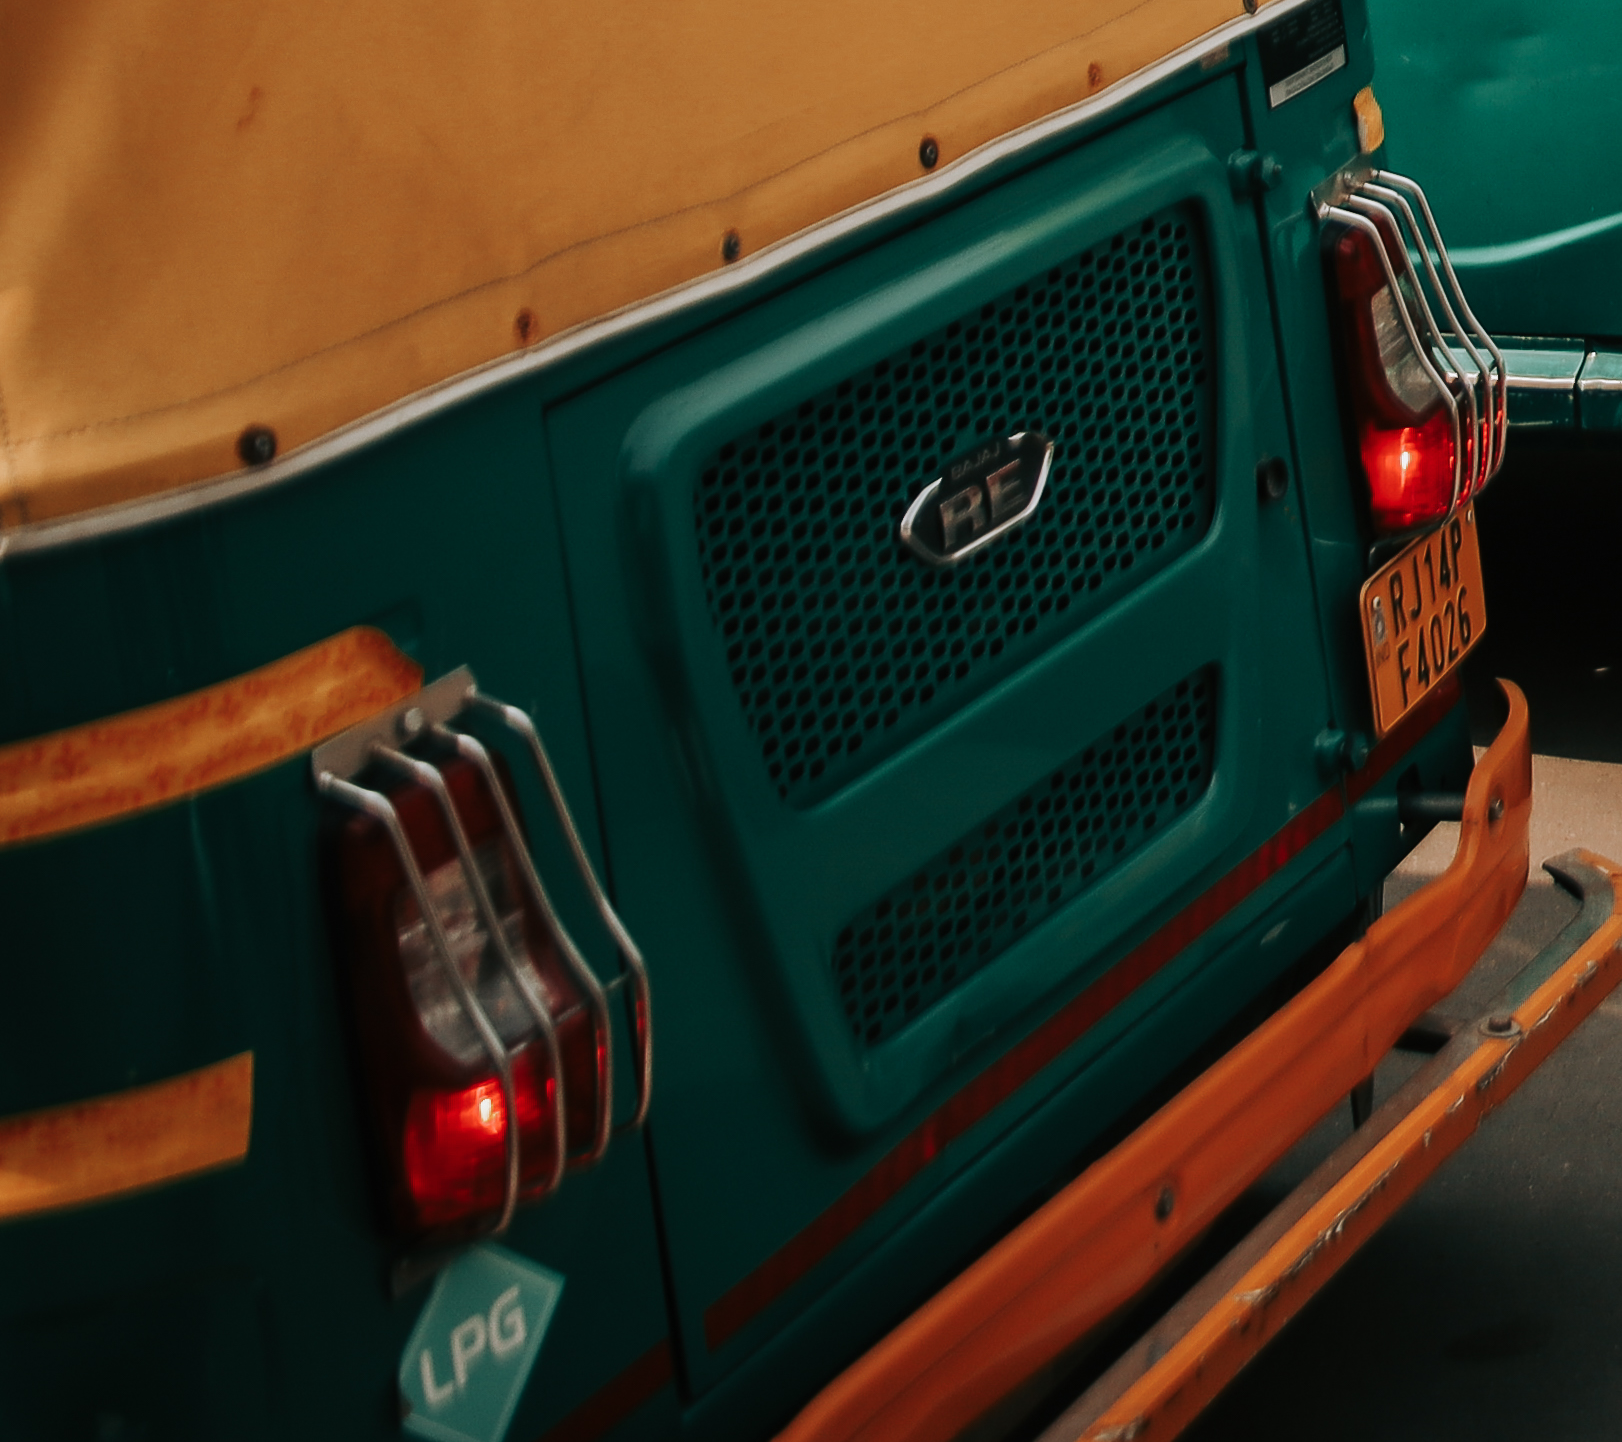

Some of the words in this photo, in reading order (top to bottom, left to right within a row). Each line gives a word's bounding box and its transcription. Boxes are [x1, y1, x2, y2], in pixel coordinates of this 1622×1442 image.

[1388, 515, 1464, 639] RJ14P
[1396, 583, 1473, 709] F4026
[419, 1282, 528, 1411] LPG
